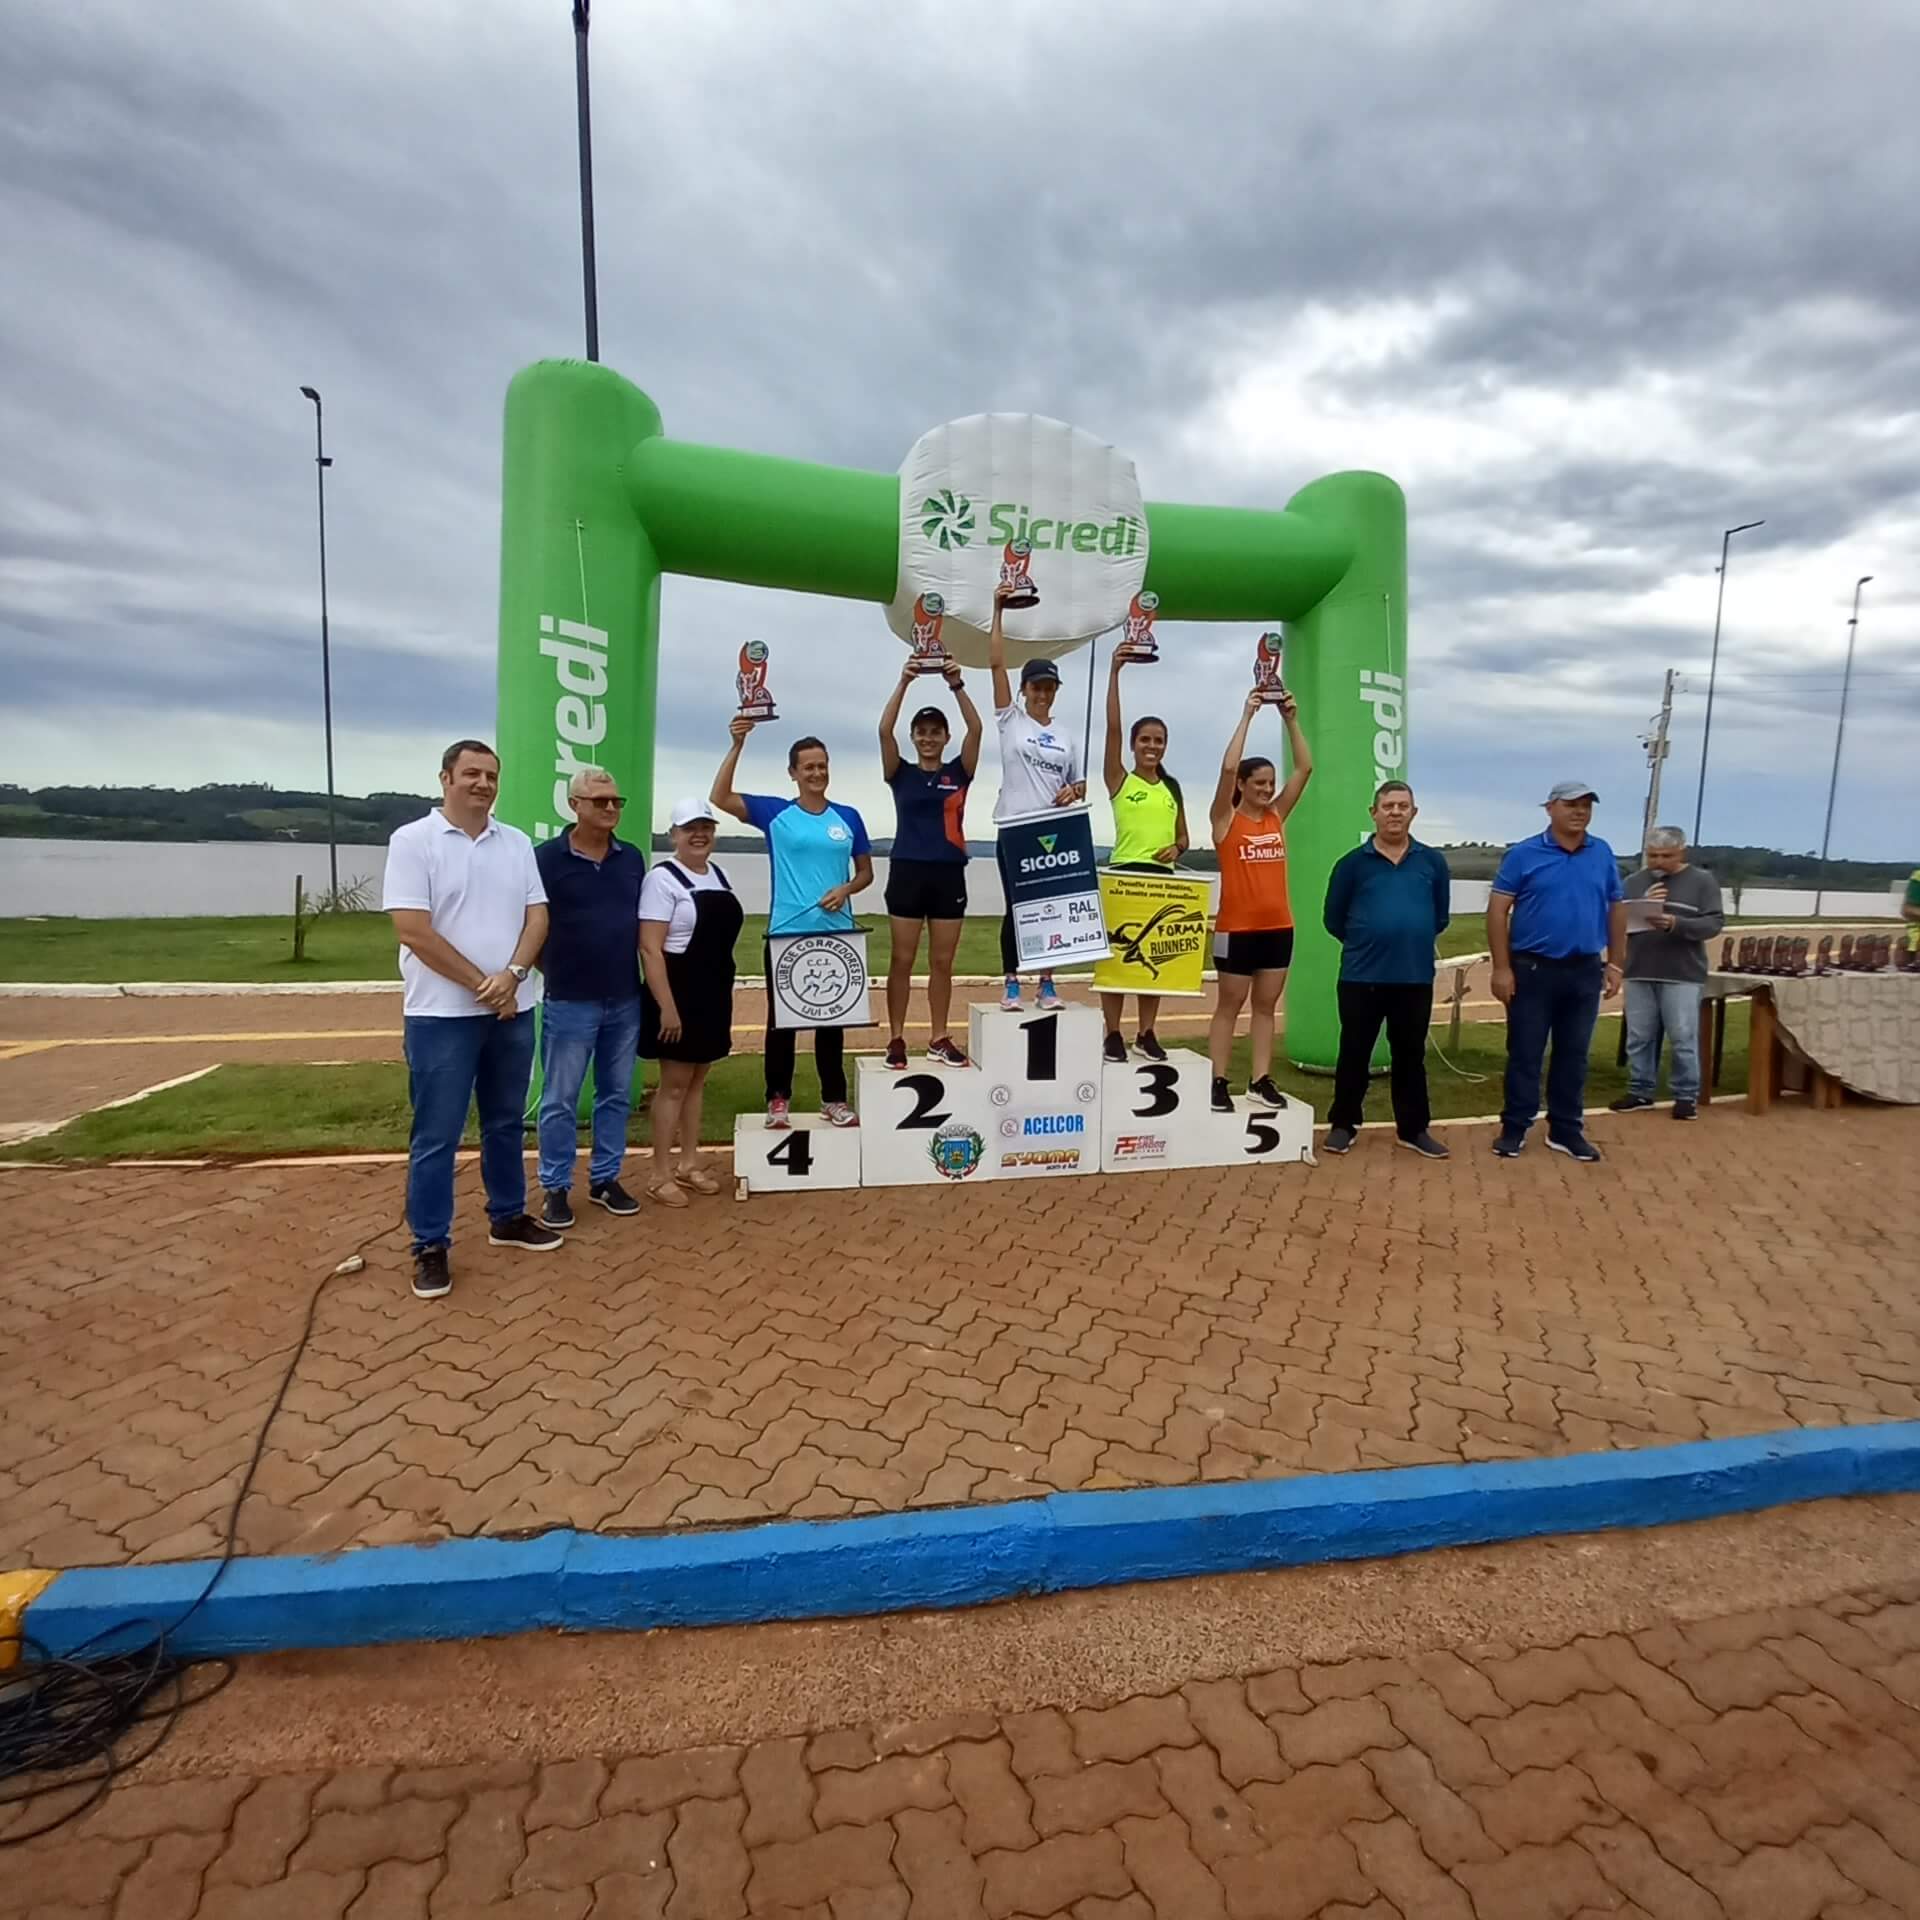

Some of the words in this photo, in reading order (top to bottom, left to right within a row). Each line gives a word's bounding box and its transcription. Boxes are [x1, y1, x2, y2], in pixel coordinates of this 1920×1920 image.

[986, 503, 1138, 556] Sicredi
[1020, 850, 1081, 873] SICOOB
[1239, 845, 1256, 860] 15
[1068, 900, 1096, 915] RAL
[1157, 922, 1205, 938] FORMA
[784, 950, 799, 962] DE
[796, 939, 861, 974] CORREDORES
[1150, 936, 1200, 956] RUNNERS
[779, 964, 791, 990] CLUBE
[851, 975, 862, 987] DE
[828, 1003, 844, 1015] RS
[1018, 1012, 1059, 1082] 1
[892, 1073, 953, 1131] 2
[1130, 1063, 1181, 1118] 3
[1023, 1114, 1085, 1136] ACELCOR
[1243, 1111, 1281, 1155] 5
[765, 1129, 815, 1176] 4
